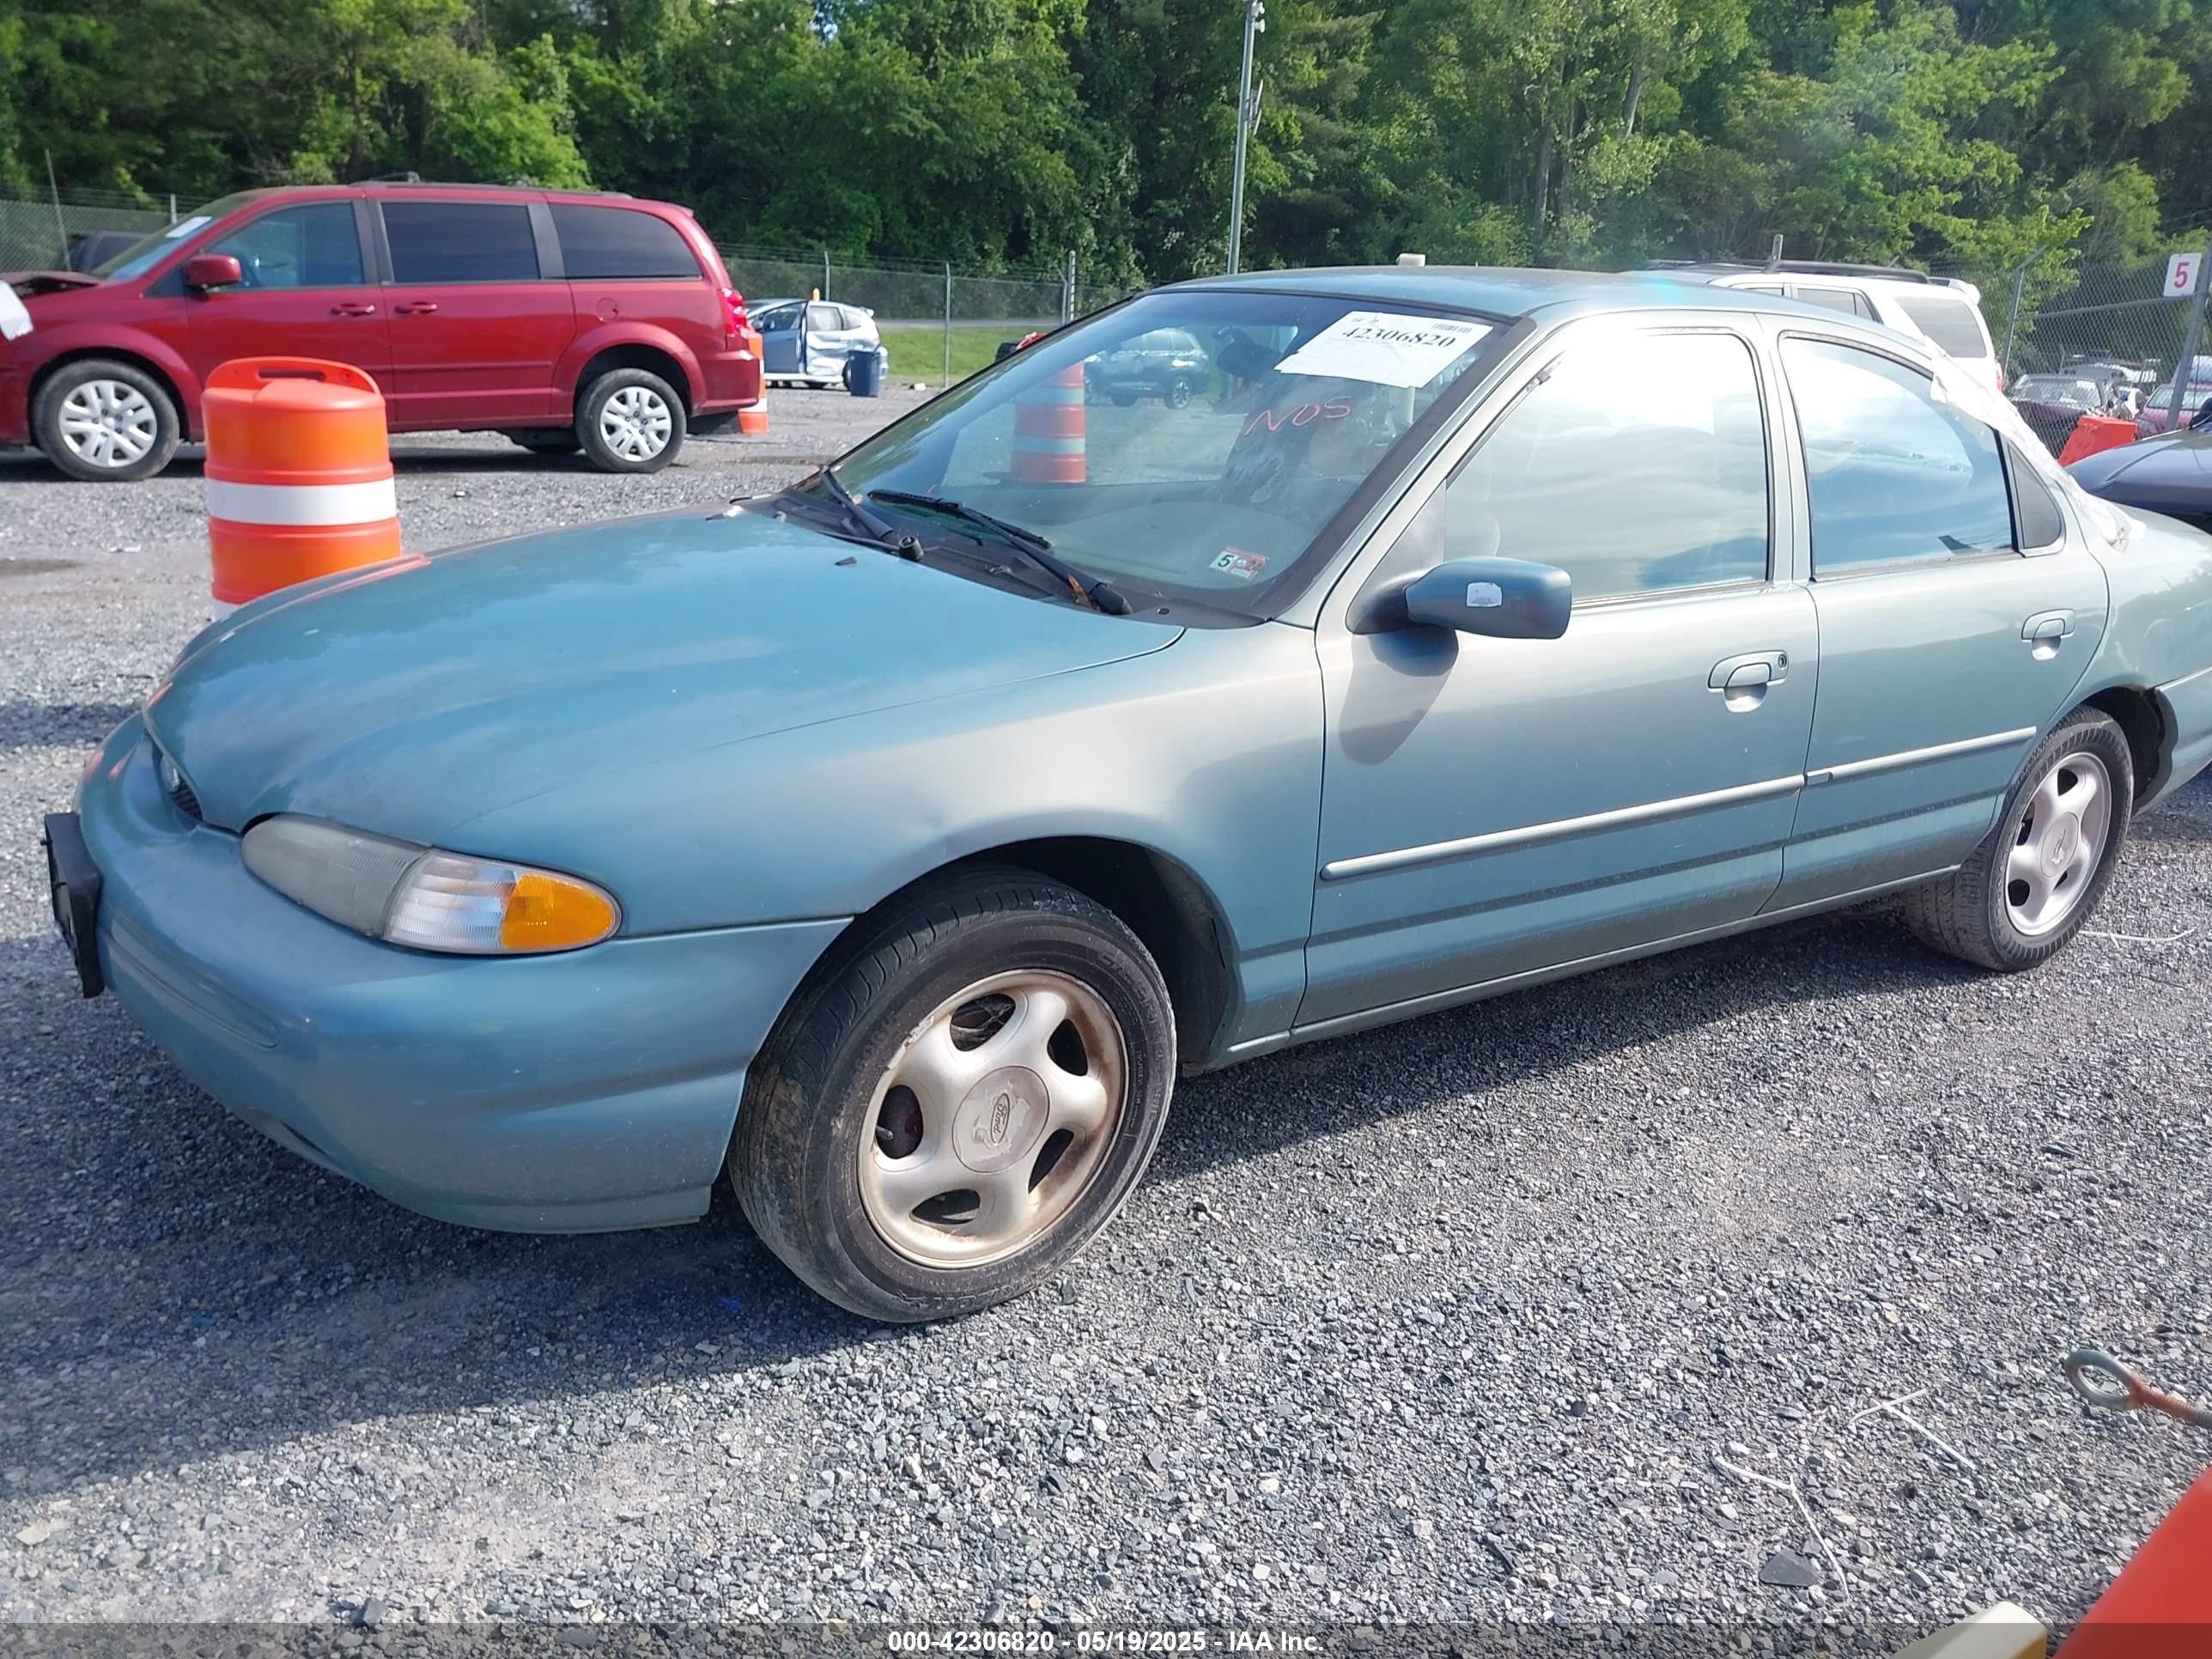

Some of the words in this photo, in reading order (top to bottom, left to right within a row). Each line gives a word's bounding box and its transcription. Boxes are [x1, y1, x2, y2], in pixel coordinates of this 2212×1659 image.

[2173, 261, 2191, 289] 5
[1341, 326, 1456, 348] 42306820
[1244, 395, 1352, 437] NOS
[1217, 553, 1235, 568] 5
